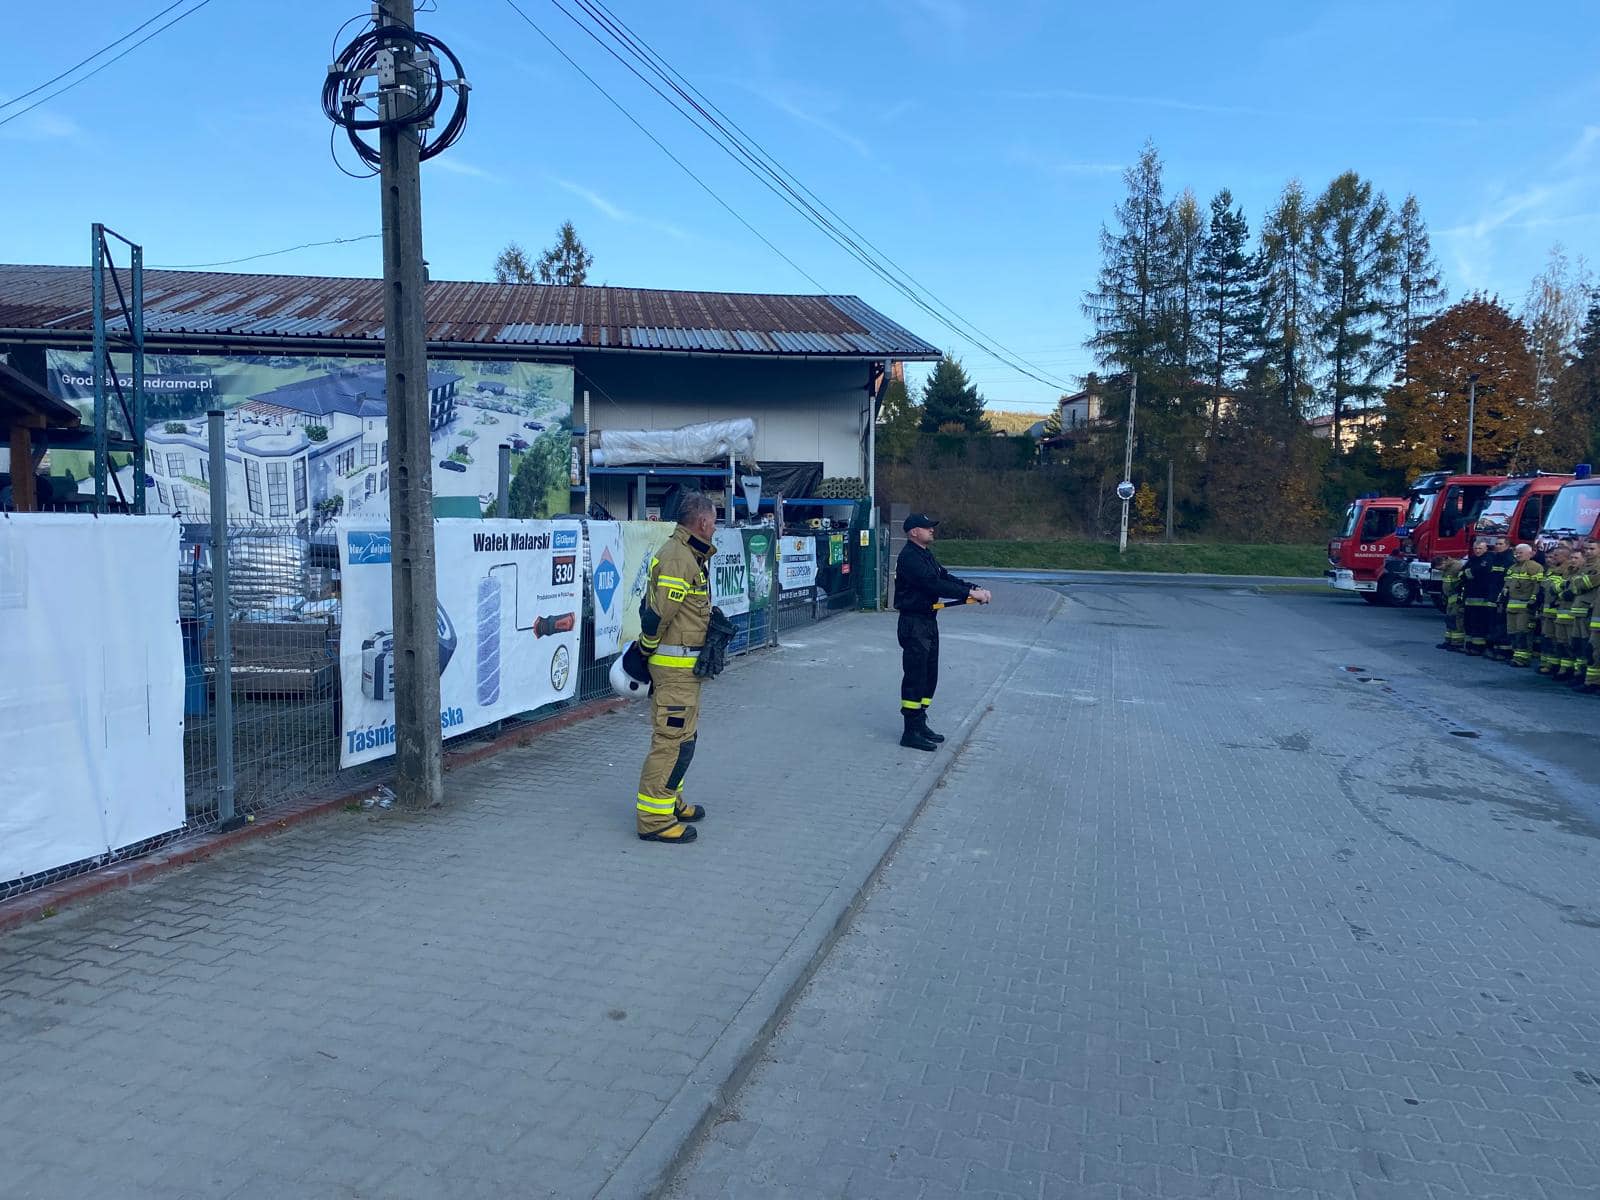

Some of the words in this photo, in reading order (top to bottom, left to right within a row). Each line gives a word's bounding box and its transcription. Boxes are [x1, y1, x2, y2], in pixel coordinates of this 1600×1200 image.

[61, 374, 213, 392] GrodsoZndrama.pl
[473, 532, 509, 552] Wałek
[510, 532, 551, 551] Malarski
[555, 563, 573, 583] 330
[598, 570, 615, 590] ATLAS
[716, 565, 745, 597] FINISZ
[670, 590, 683, 600] OSP
